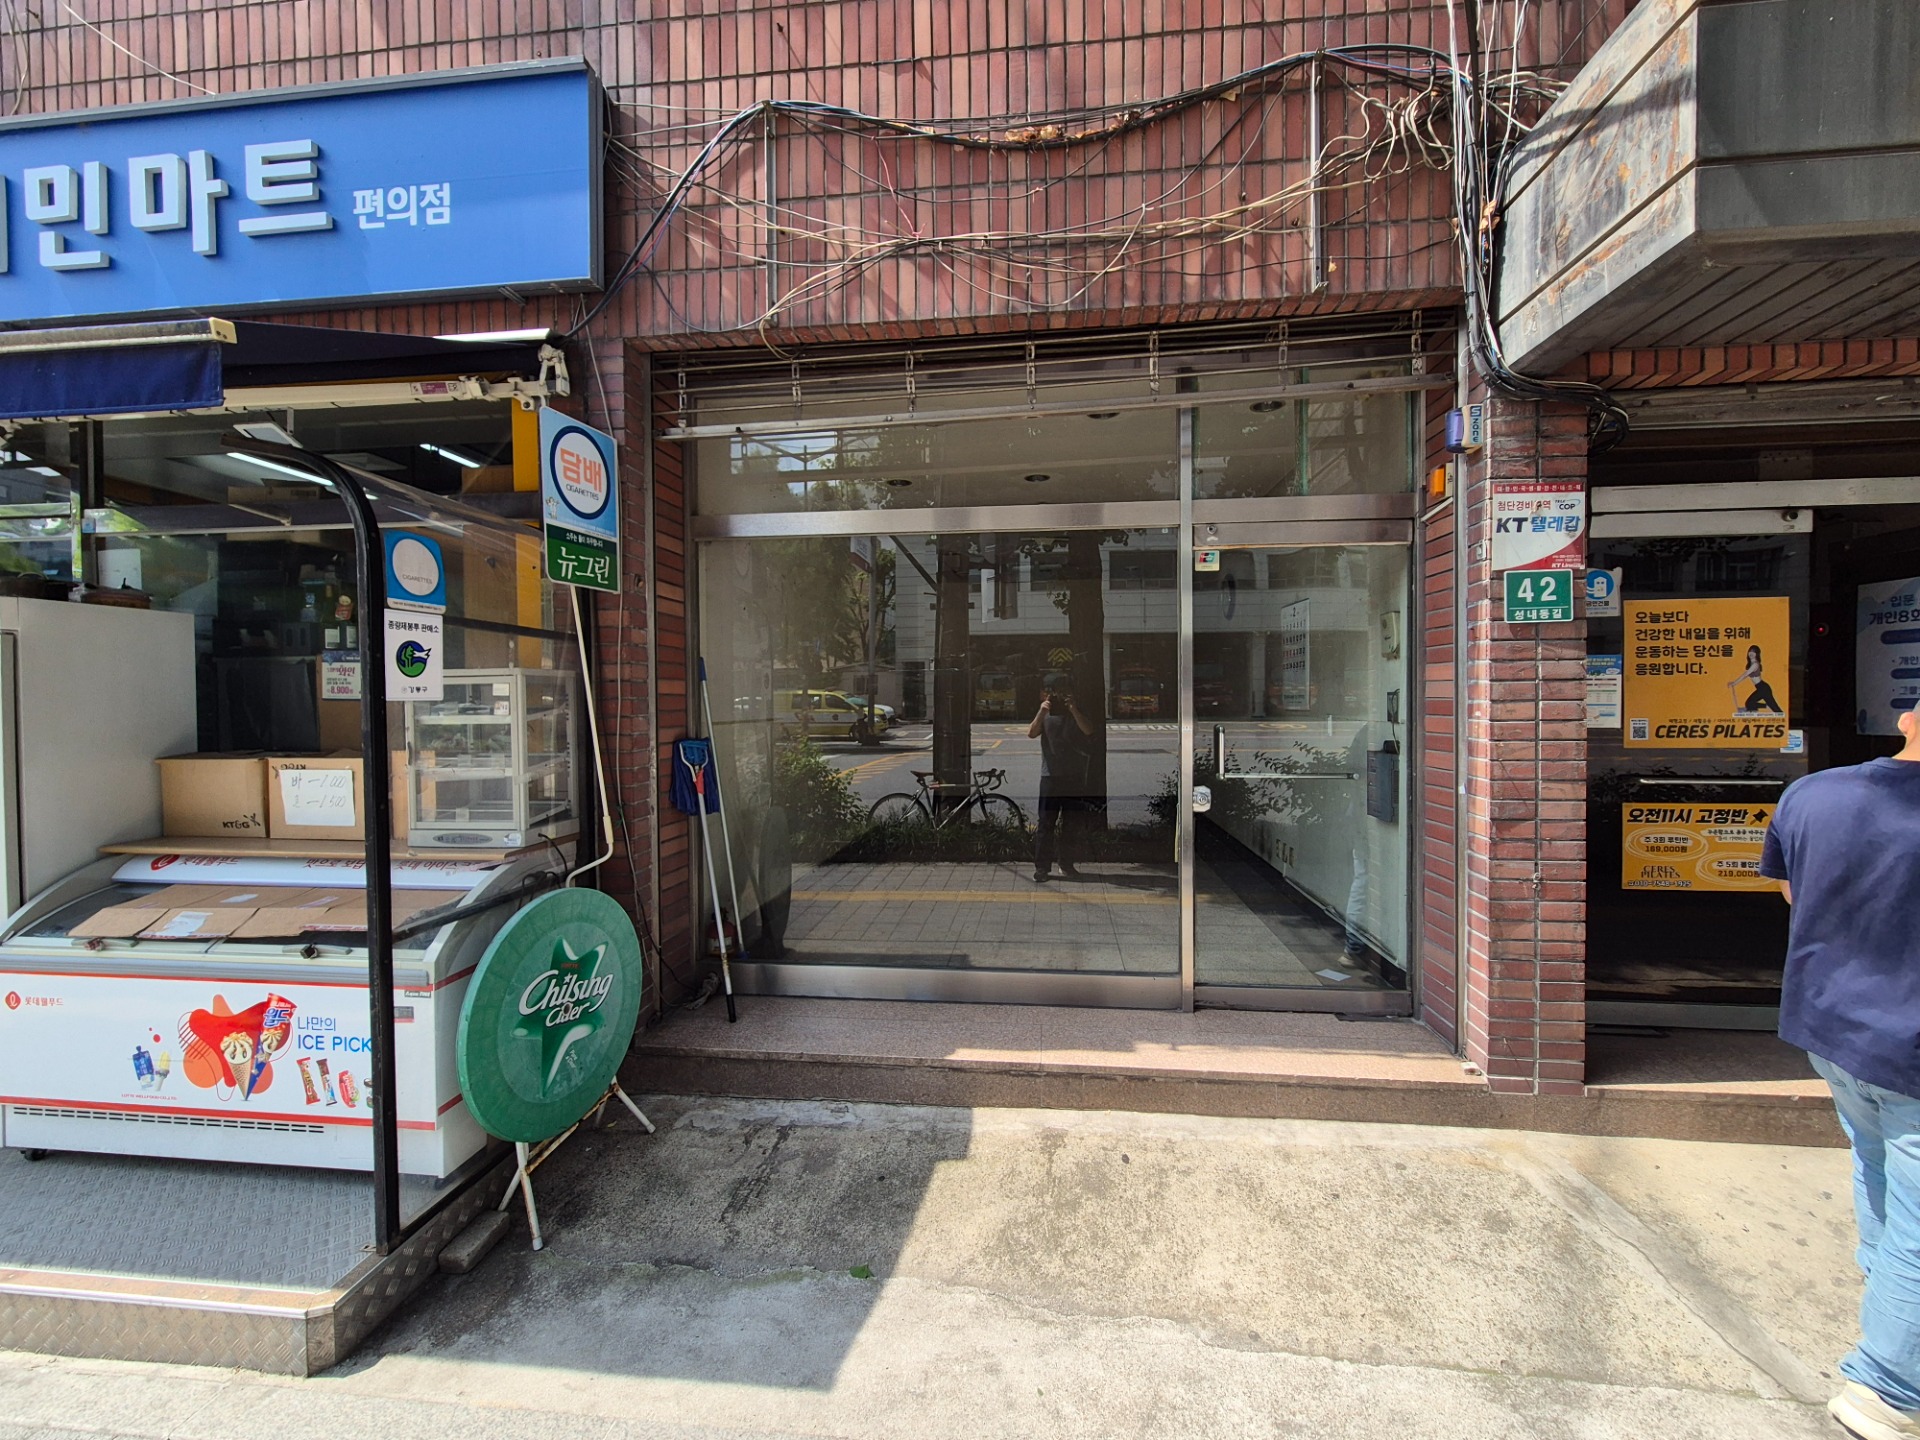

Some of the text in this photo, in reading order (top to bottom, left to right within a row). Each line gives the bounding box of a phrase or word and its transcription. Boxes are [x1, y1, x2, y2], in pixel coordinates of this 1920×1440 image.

[0, 138, 452, 274] 민마트 편의점
[560, 447, 603, 493] 담배
[1559, 503, 1576, 511] COP
[1496, 515, 1581, 533] KT 텔레캅
[557, 546, 610, 584] 뉴그린
[402, 573, 433, 585] CIGARETTES
[1517, 576, 1558, 603] 42
[1634, 610, 1690, 624] 오늘보다
[1634, 626, 1751, 641] 건강한 내일을 위해
[1634, 644, 1734, 658] 운동하는 당신을
[1634, 662, 1708, 676] 응원합니다.
[1655, 724, 1785, 739] CERES PILATES
[291, 772, 303, 789] 바
[1627, 808, 1749, 824] 오전11시 고정반
[222, 820, 250, 829] KT&G
[1643, 865, 1676, 873] CERES
[1716, 860, 1724, 868] 주
[518, 969, 615, 1016] Chilsung
[263, 1006, 291, 1028] 월드
[297, 1016, 337, 1032] 나만의
[297, 1034, 373, 1053] ICE PICK
